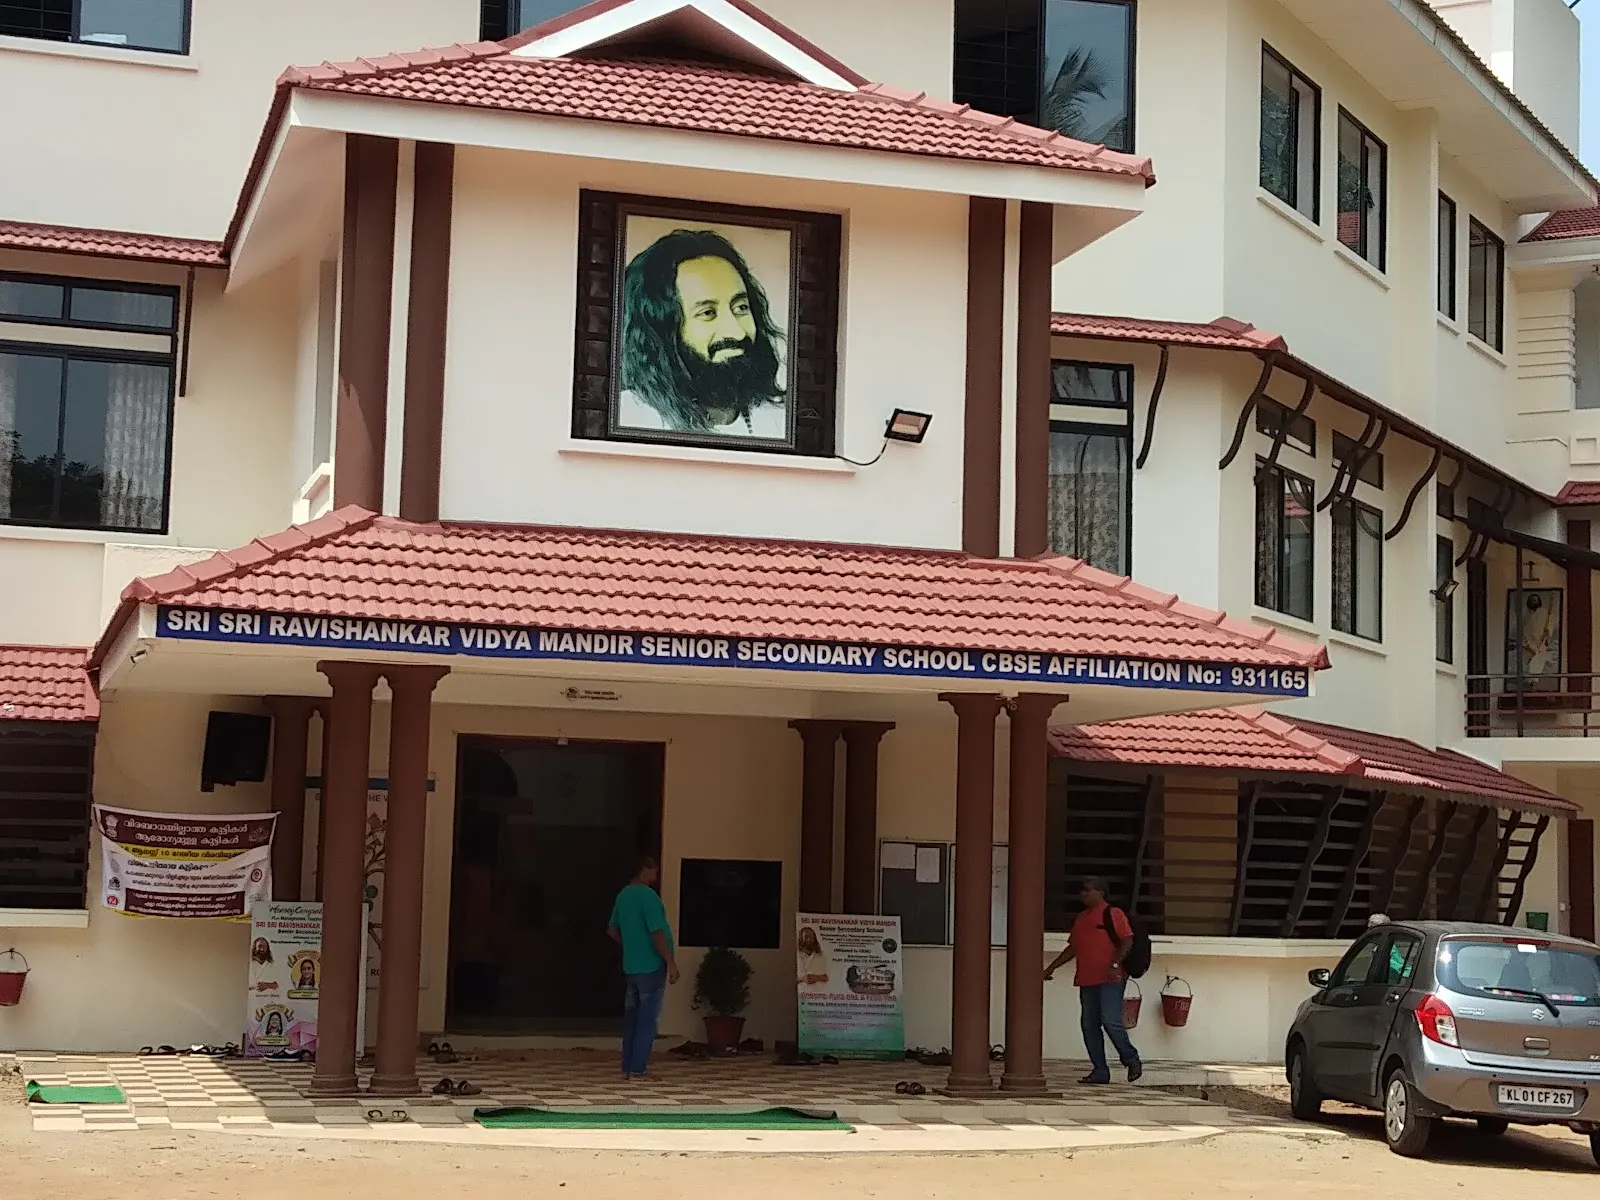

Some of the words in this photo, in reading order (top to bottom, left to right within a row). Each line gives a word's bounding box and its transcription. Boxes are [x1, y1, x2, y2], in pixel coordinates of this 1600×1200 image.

[168, 611, 209, 631] SRI
[219, 614, 260, 635] SRI
[270, 617, 450, 646] RAVISHANKAR
[460, 629, 531, 650] VIDYA
[540, 632, 633, 655] MANDIR
[641, 637, 729, 659] SENIOR
[738, 641, 877, 667] SECONDARY
[884, 649, 976, 671] SCHOOL
[982, 653, 1041, 674] CBSE
[1047, 657, 1181, 682] AFFILIATION
[1188, 665, 1224, 684] No:
[1231, 668, 1306, 689] 931165
[1507, 1089, 1520, 1101] KL
[1522, 1090, 1534, 1102] 01
[1537, 1091, 1550, 1103] CF
[1553, 1093, 1573, 1105] 267
